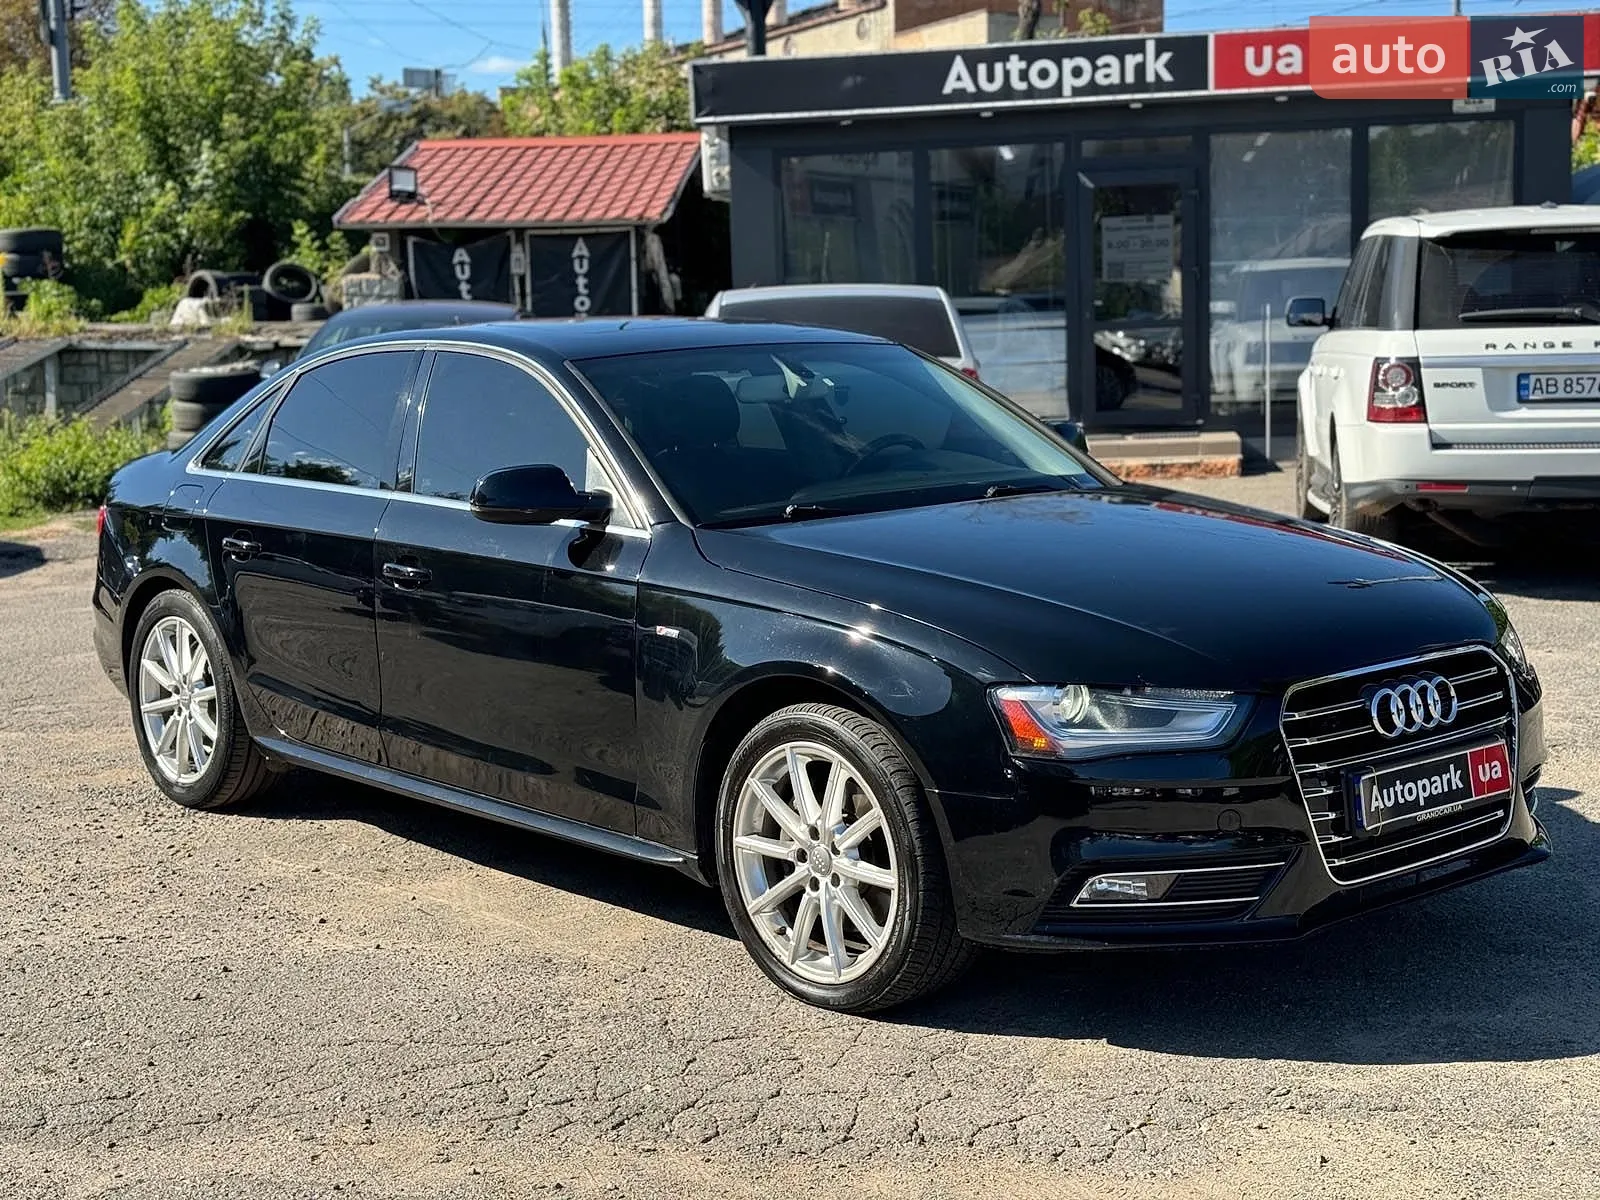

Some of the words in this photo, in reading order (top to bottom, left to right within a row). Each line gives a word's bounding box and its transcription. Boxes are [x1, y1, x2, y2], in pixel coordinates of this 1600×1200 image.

[942, 39, 1174, 97] Autopark
[1244, 43, 1303, 77] ua
[571, 236, 592, 317] Auto
[1485, 341, 1573, 350] RANGE
[1433, 381, 1477, 389] SPORT
[1532, 377, 1559, 395] AB
[1563, 376, 1600, 394] 857
[1370, 763, 1465, 813] Autopark
[1478, 758, 1503, 783] ua
[1416, 803, 1463, 822] GRANDCAR.UA
